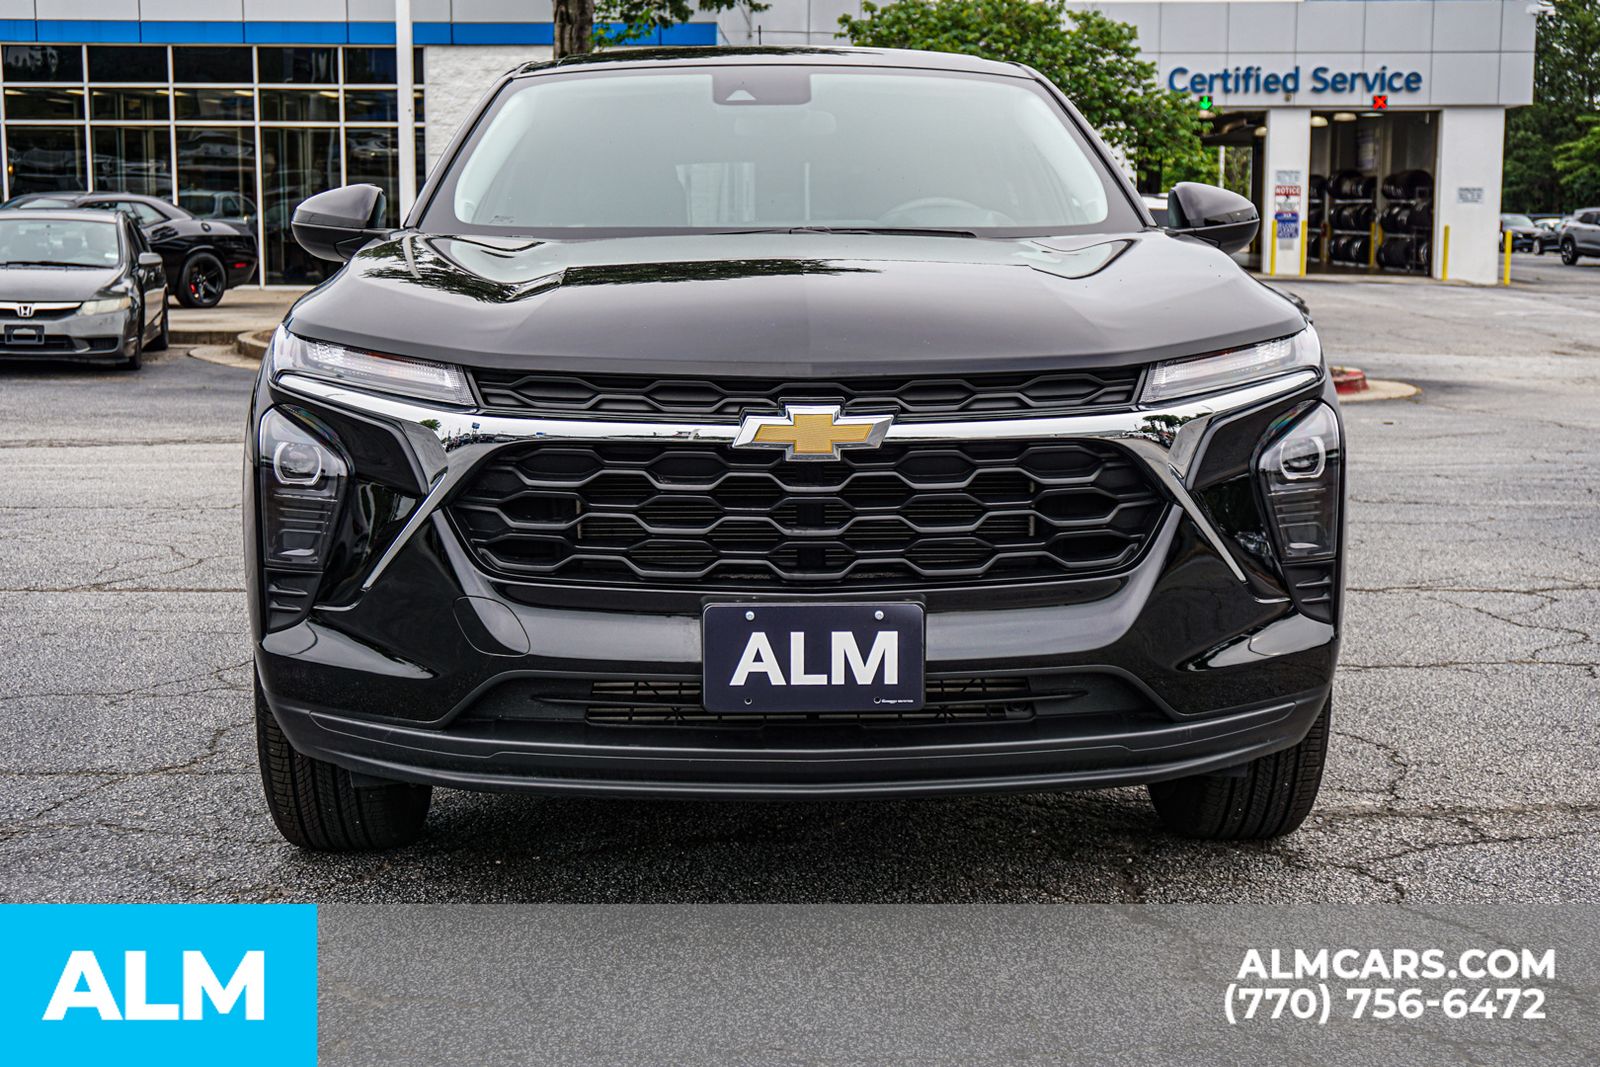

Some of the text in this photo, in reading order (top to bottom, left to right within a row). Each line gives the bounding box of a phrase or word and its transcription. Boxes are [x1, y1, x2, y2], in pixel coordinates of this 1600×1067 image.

[1168, 65, 1423, 94] Certified Service
[1275, 186, 1300, 195] NOTICE
[729, 631, 898, 686] ALM
